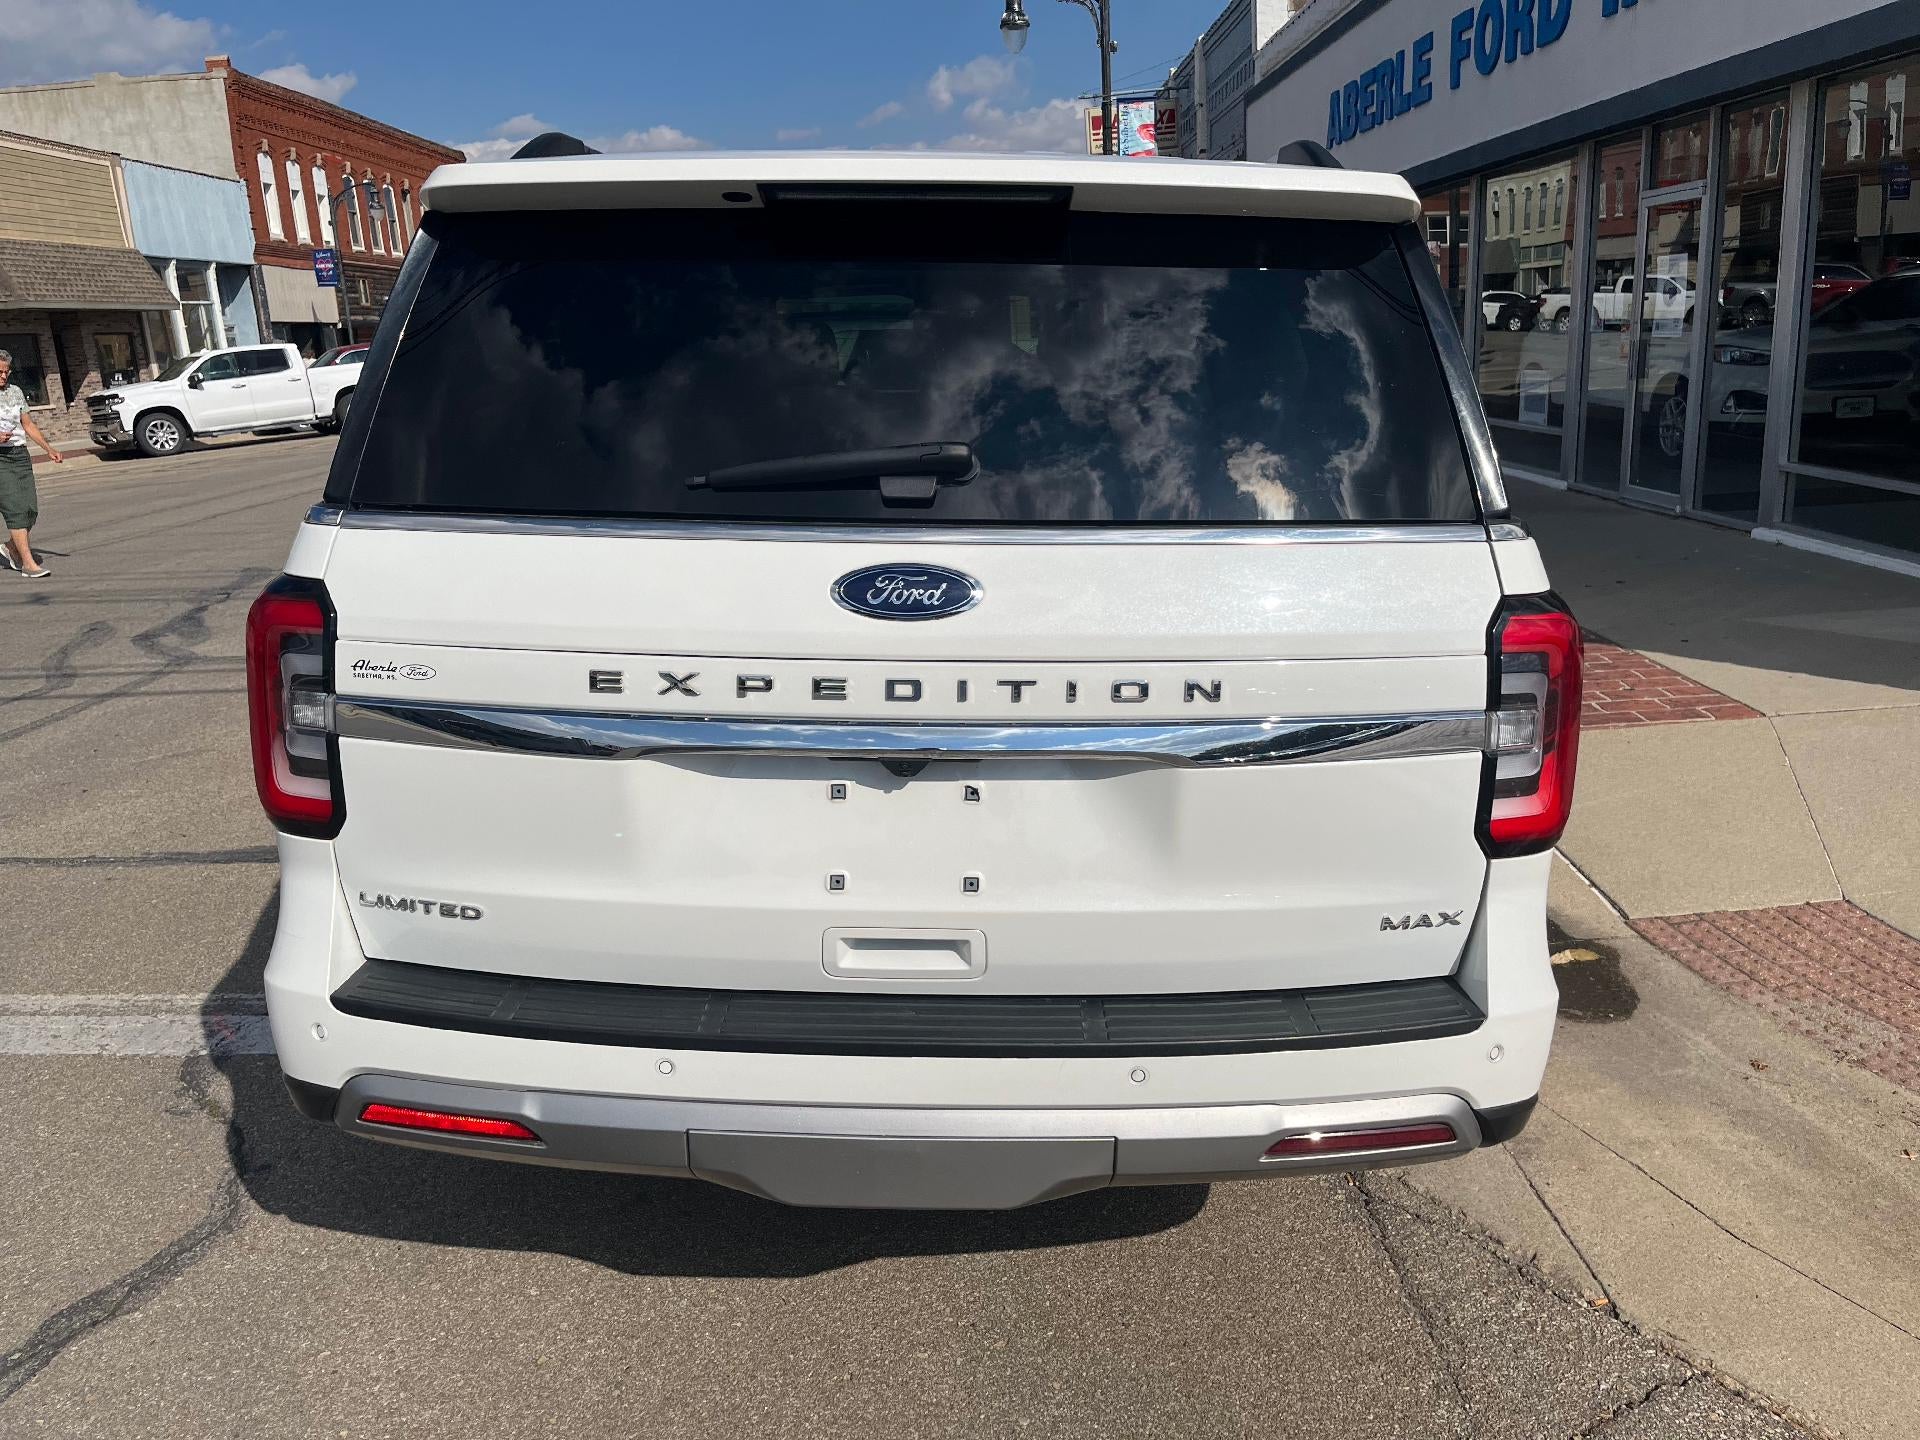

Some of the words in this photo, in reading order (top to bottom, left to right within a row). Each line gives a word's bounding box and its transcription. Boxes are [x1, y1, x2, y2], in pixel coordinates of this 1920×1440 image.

[1326, 31, 1433, 150] ABERLE
[1450, 0, 1572, 90] FORD
[866, 573, 947, 605] Ford
[350, 659, 398, 673] Aberle
[352, 672, 385, 680] SABETHA,
[406, 666, 429, 677] Ford
[588, 668, 1222, 703] EXPEDITION
[359, 891, 483, 921] LIMITED
[1379, 909, 1464, 931] MAX
